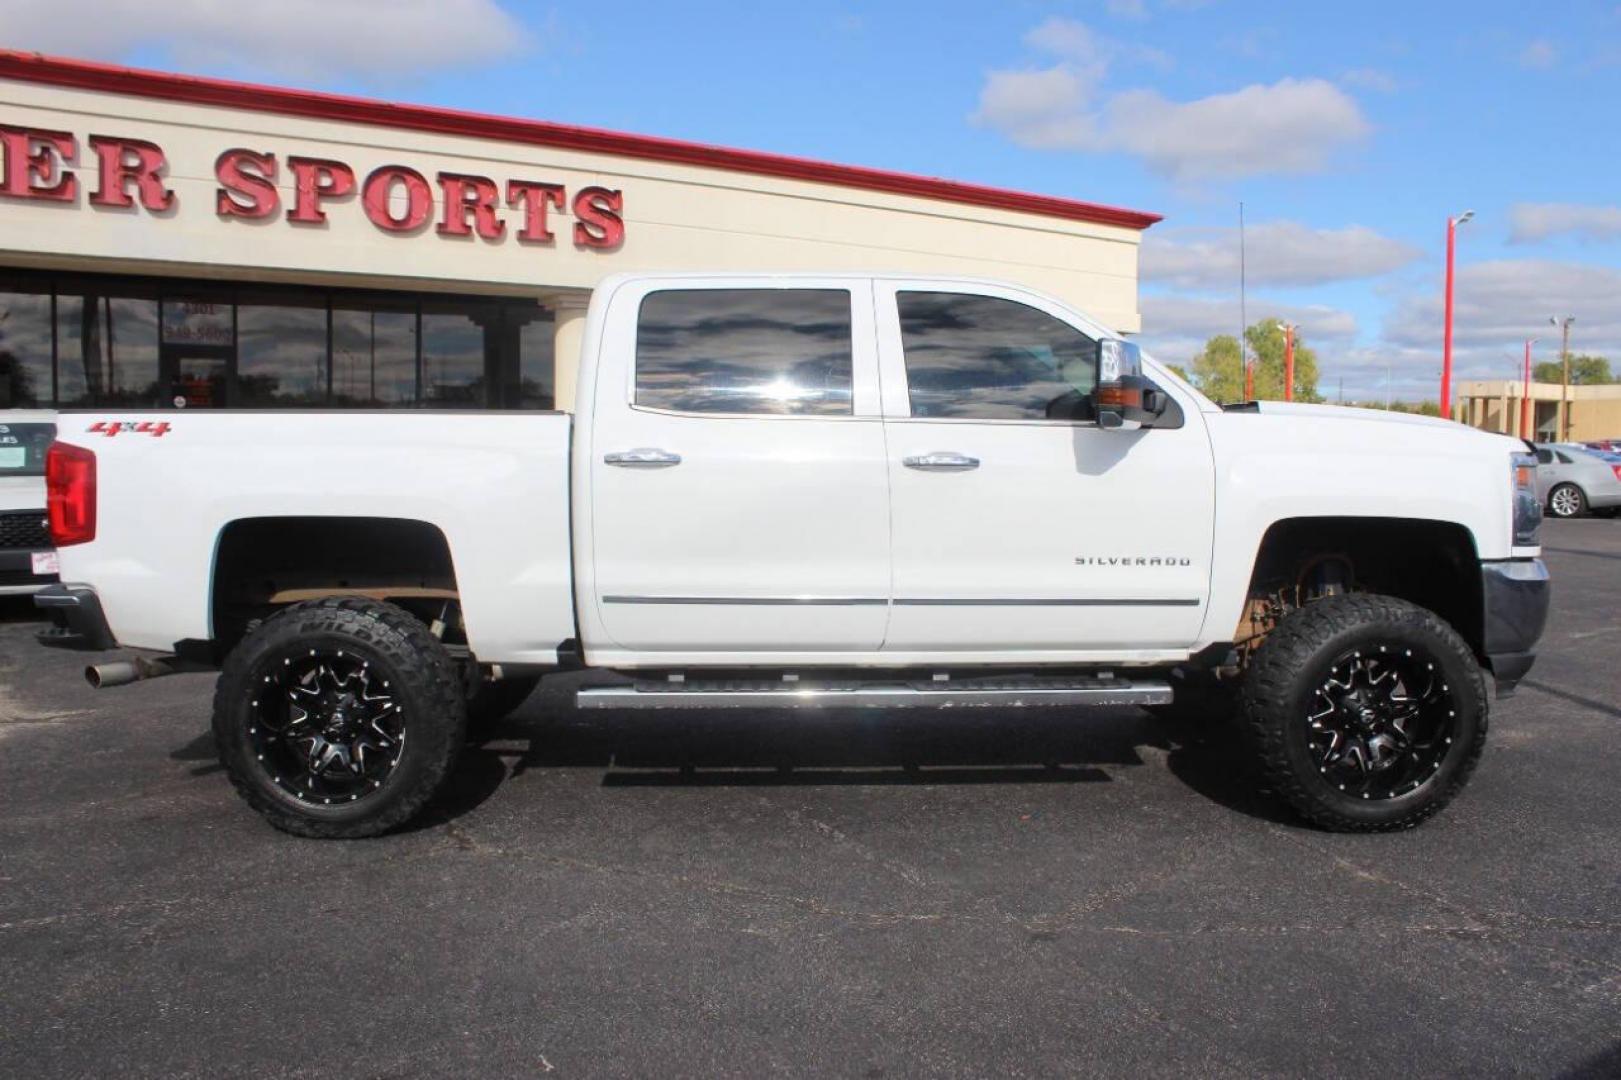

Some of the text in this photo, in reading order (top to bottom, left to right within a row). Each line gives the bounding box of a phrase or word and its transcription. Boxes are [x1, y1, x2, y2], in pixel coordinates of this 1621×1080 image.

[0, 123, 625, 248] ER SPORTS
[1075, 557, 1191, 566] SILVERADO
